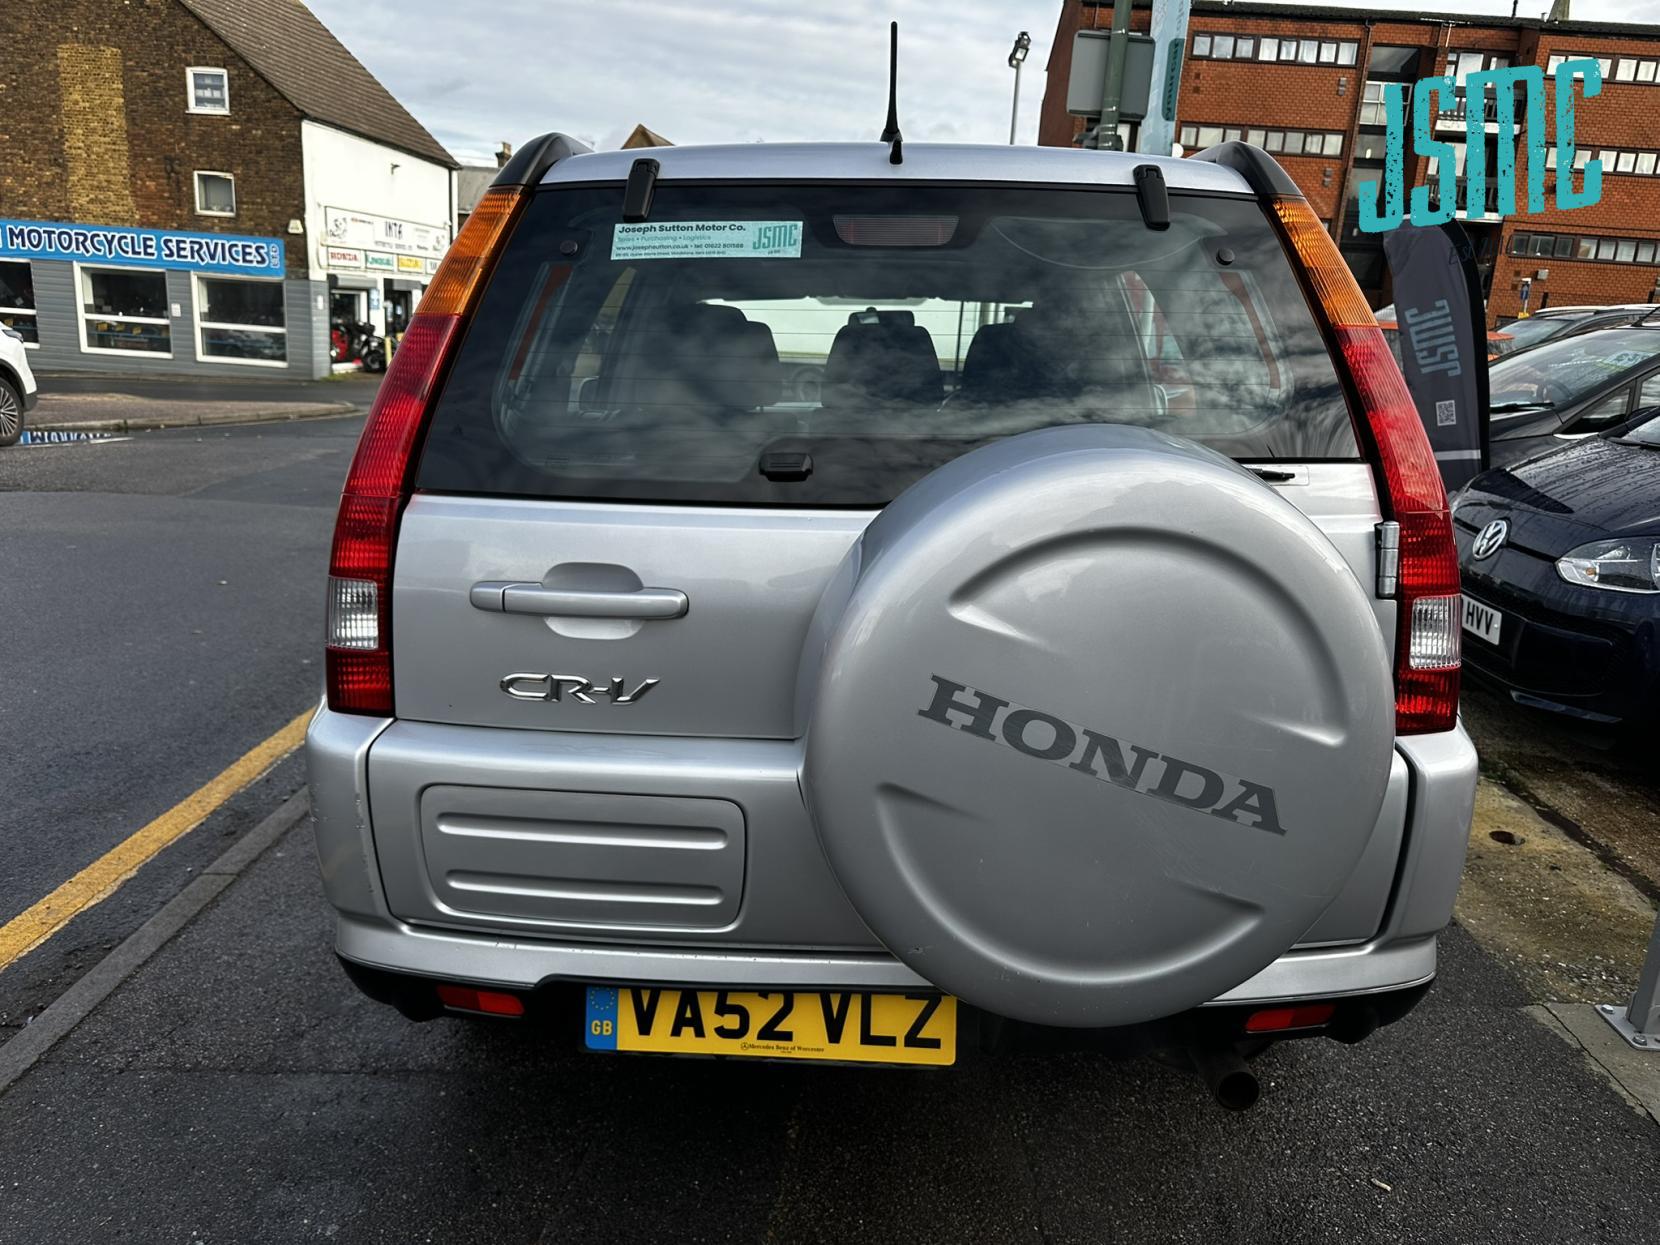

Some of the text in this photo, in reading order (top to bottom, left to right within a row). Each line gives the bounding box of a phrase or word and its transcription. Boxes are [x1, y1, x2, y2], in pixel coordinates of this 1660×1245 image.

[618, 223, 746, 235] Joseph Sutton Motor Co.
[752, 224, 798, 250] JSMC
[8, 227, 156, 257] MOTORCYCLE
[161, 238, 269, 266] SERVICES
[1403, 299, 1462, 377] JSMC
[1466, 602, 1494, 635] HVV
[500, 671, 661, 705] CR-V
[917, 672, 1288, 837] HONDA
[591, 1020, 613, 1036] GB
[629, 989, 942, 1049] VA52 VLZ
